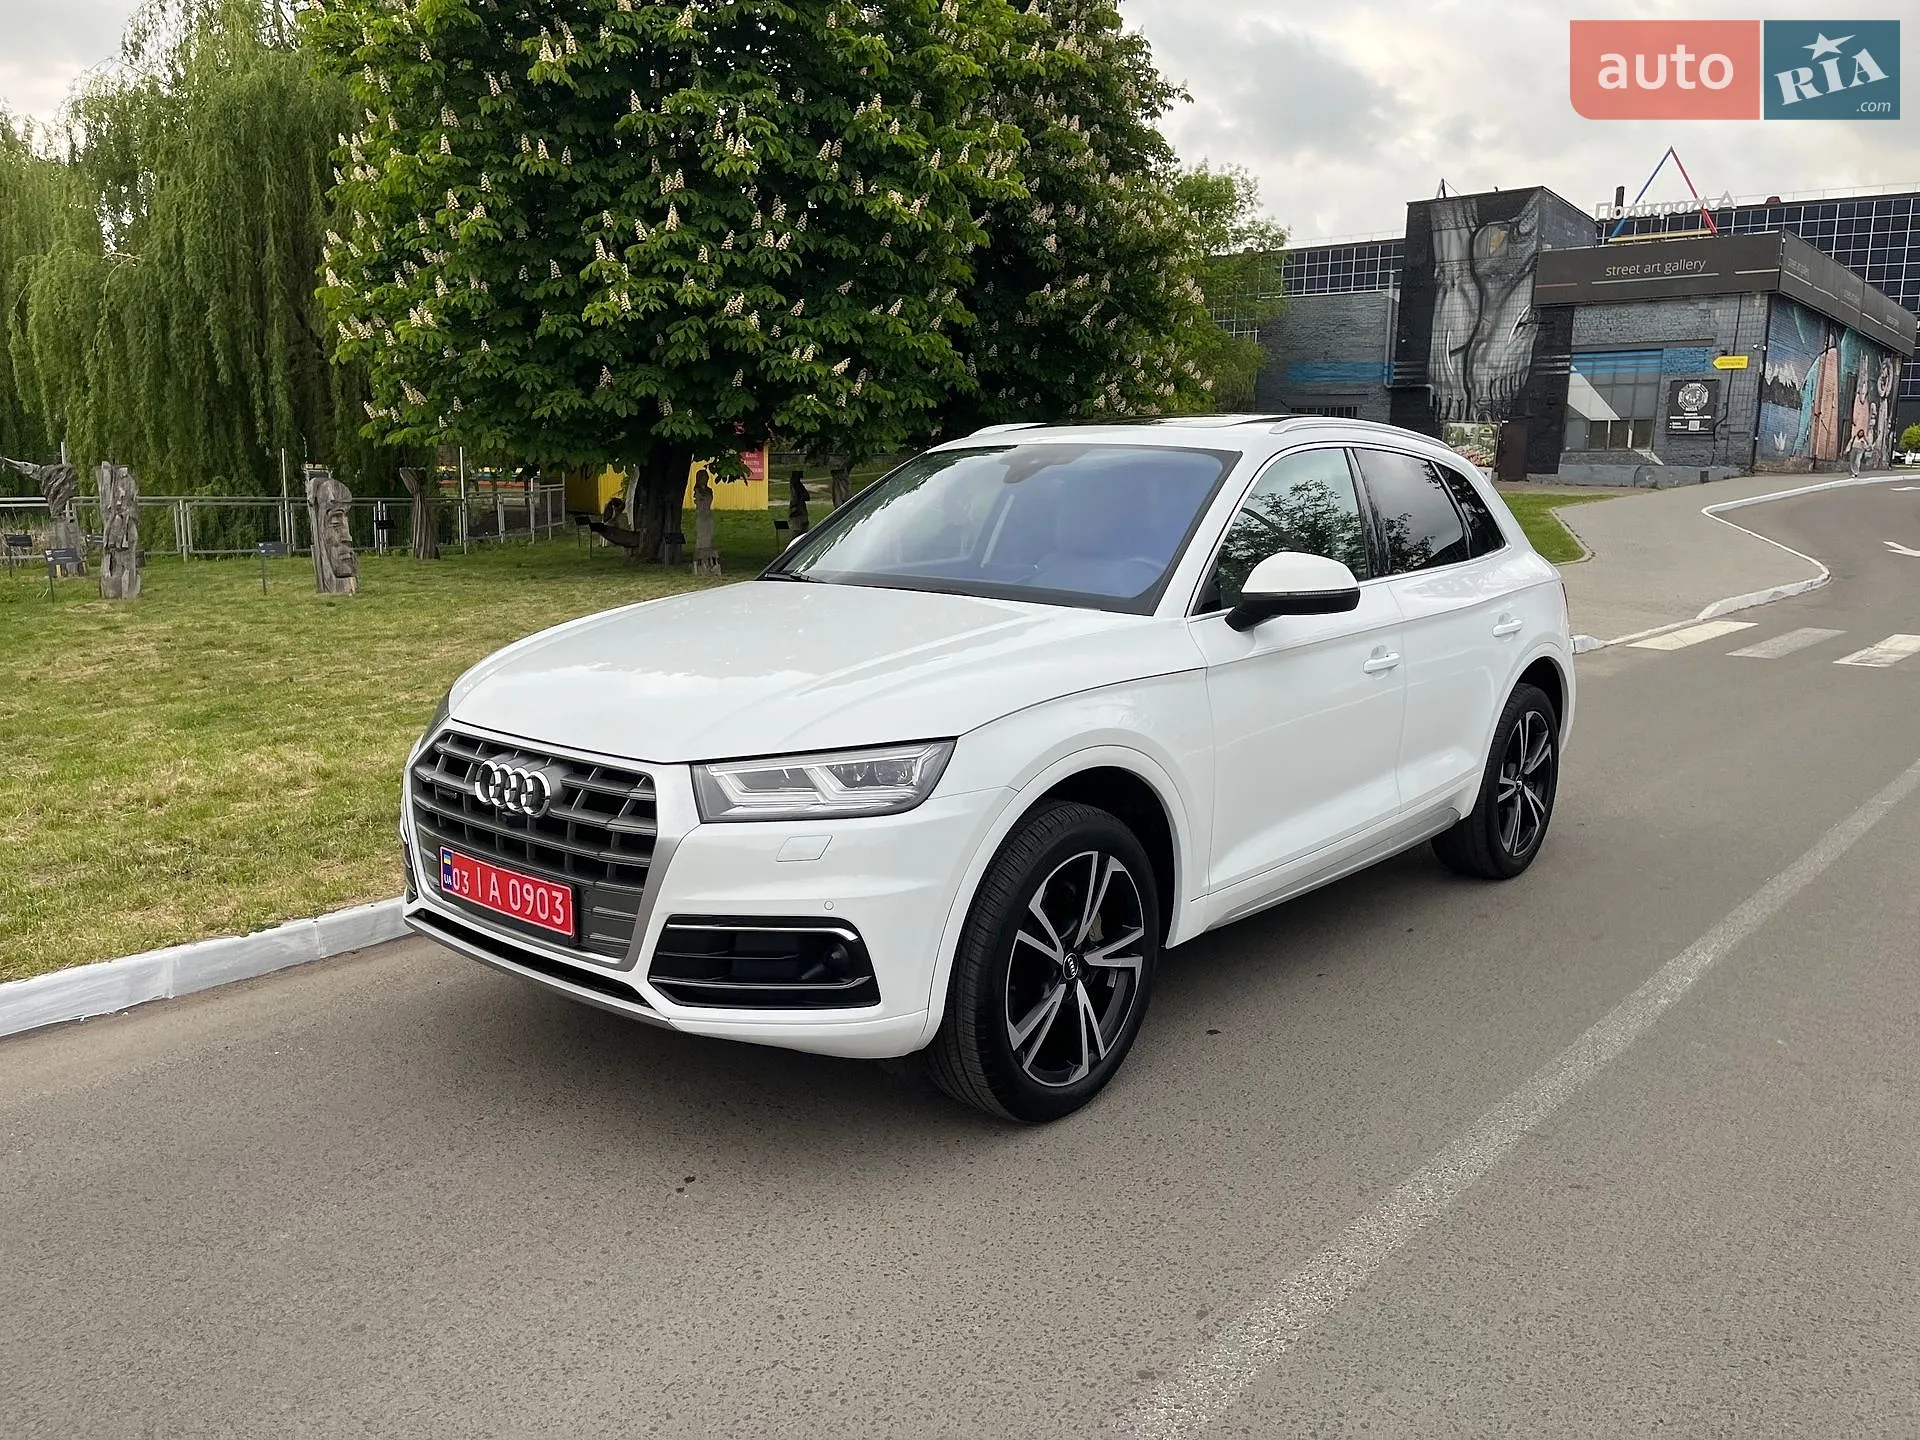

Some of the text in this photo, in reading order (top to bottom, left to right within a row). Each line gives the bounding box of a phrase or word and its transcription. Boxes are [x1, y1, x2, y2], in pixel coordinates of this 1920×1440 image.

[1605, 258, 1707, 277] street art gallery
[443, 873, 453, 886] UA
[452, 867, 470, 895] 03
[508, 878, 565, 926] 0903
